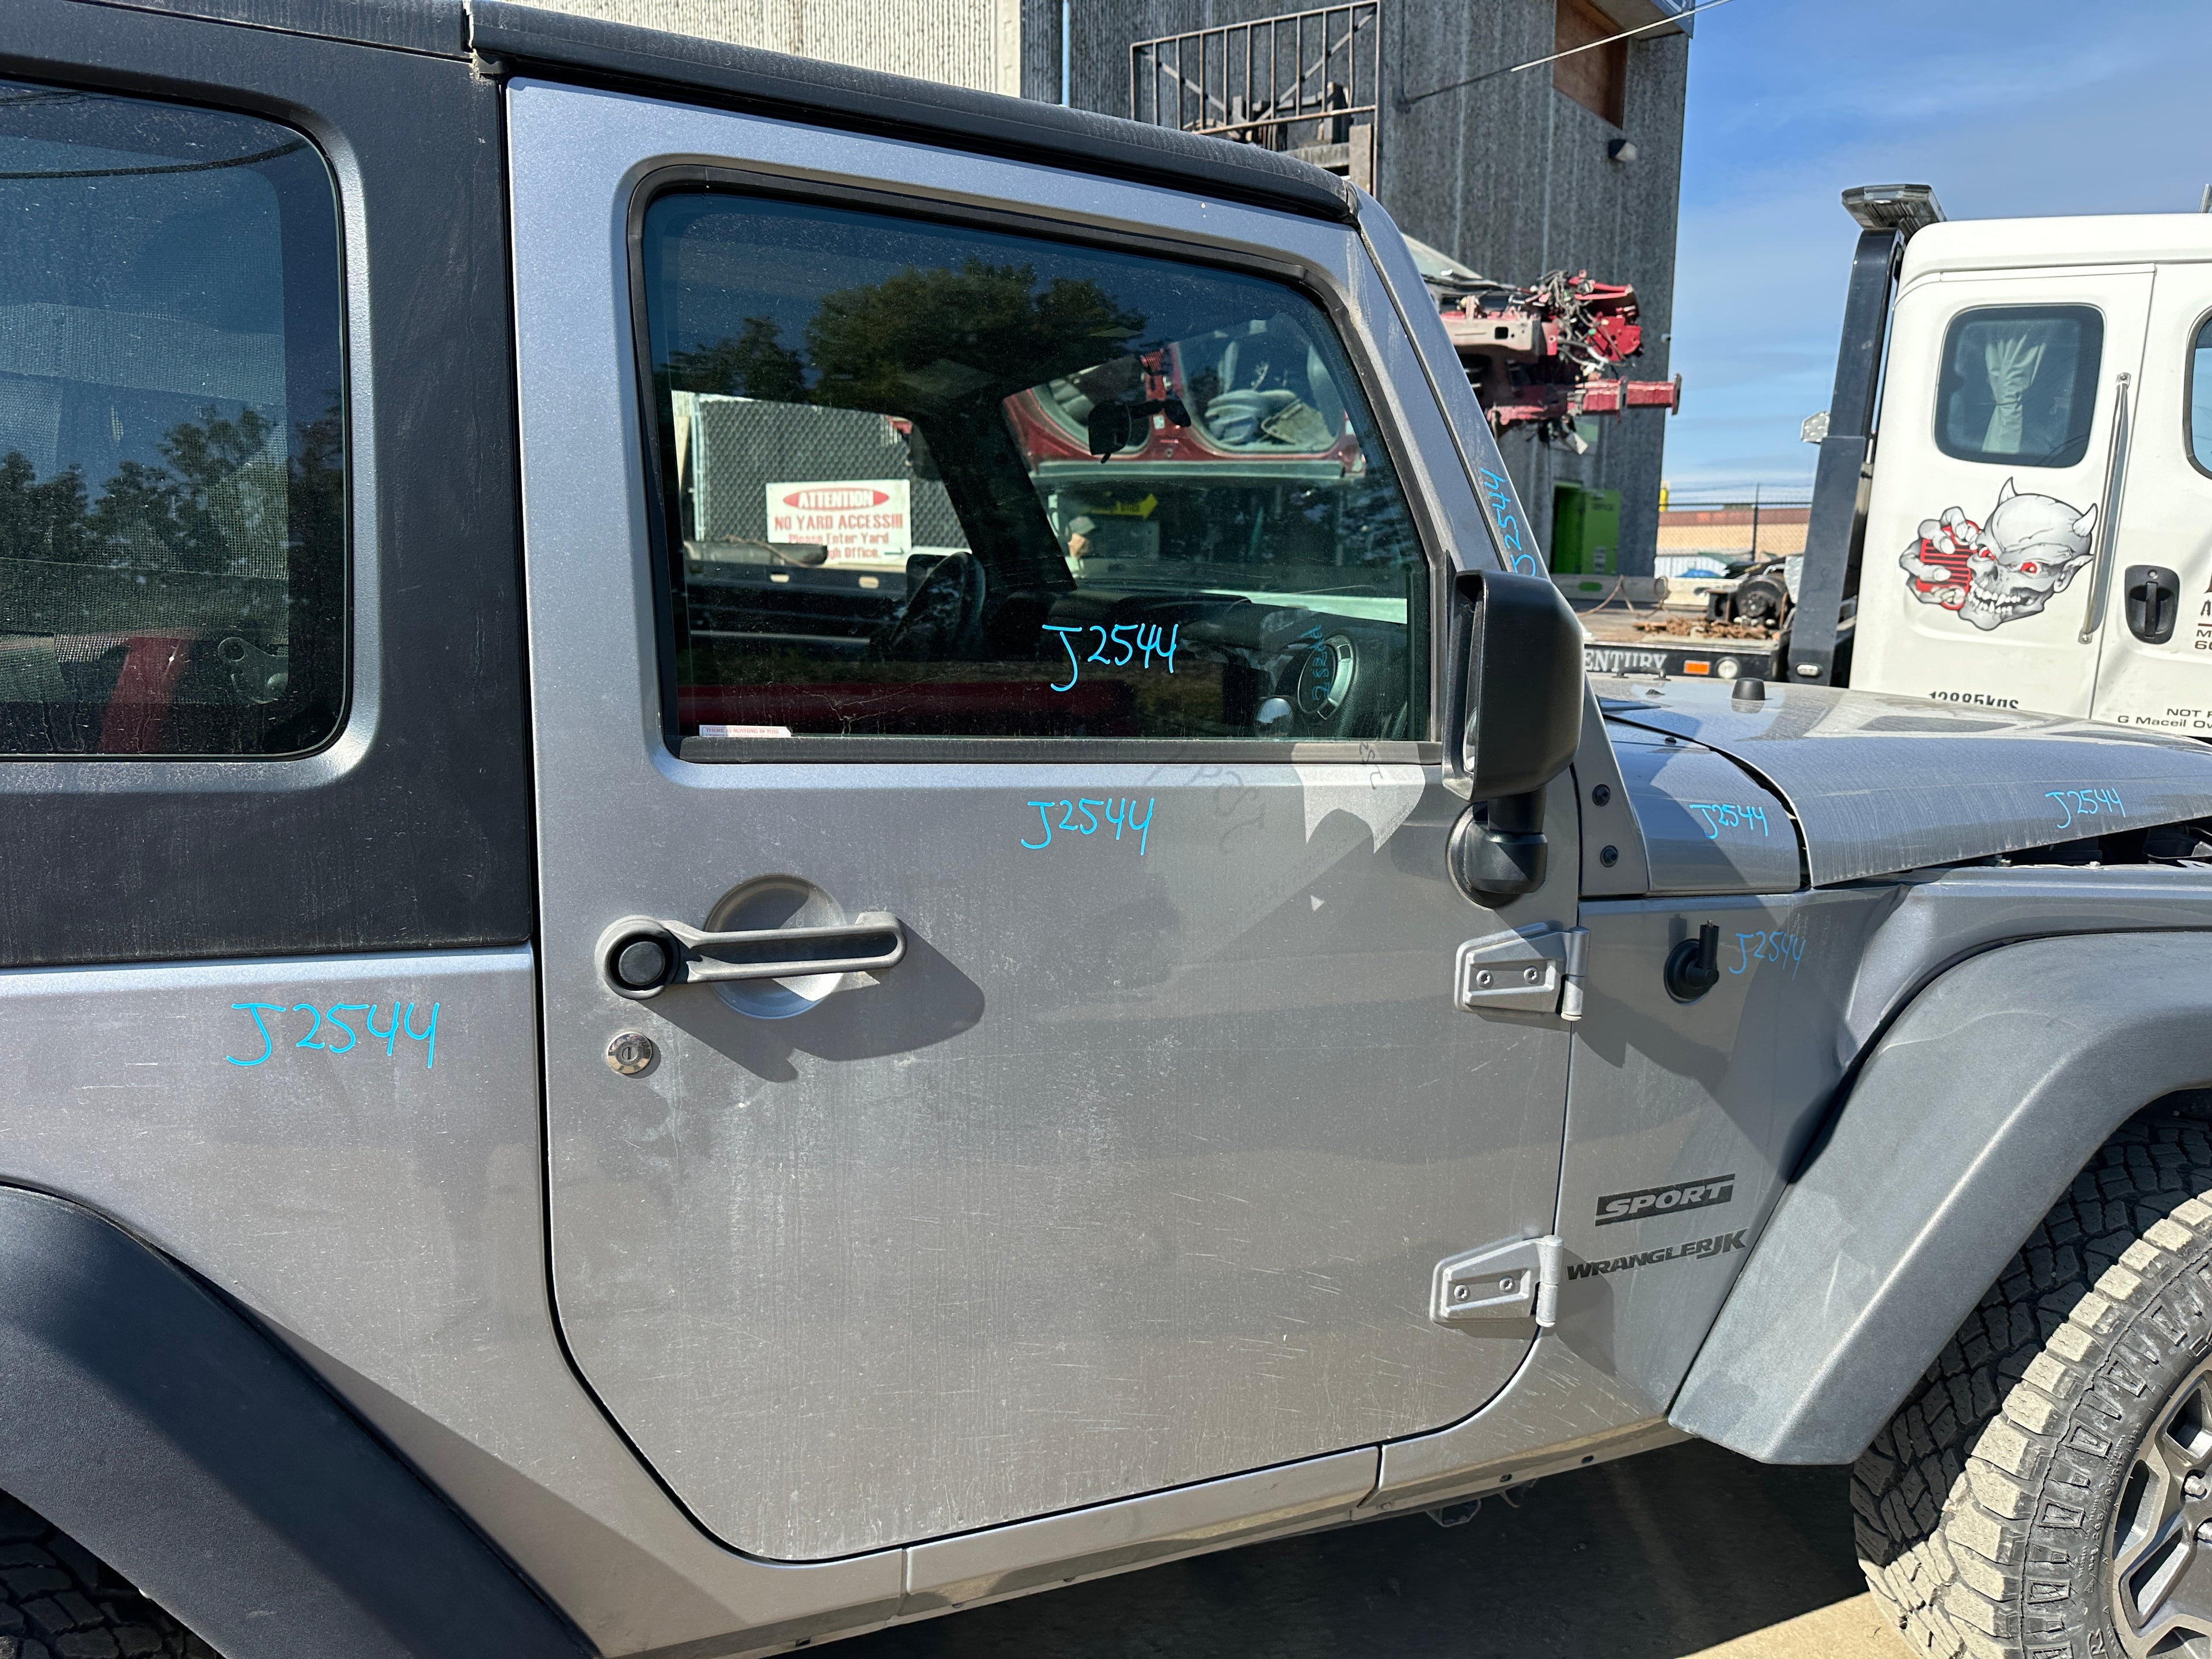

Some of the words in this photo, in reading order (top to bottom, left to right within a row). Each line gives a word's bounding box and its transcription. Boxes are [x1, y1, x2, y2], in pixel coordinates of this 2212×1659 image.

[798, 490, 874, 508] ATTENTION
[775, 515, 791, 531] NO
[797, 514, 834, 531] YARD
[827, 533, 858, 544] Enter
[861, 532, 889, 544] Yard
[1480, 467, 1536, 576] J2544
[1041, 623, 1179, 692] J2544
[1584, 649, 1667, 672] ENTURY
[2118, 715, 2130, 724] G
[2166, 709, 2202, 717] NOT
[1021, 797, 1155, 856] J2544
[1689, 804, 1768, 840] J2544
[2045, 787, 2126, 829] J2544
[1729, 931, 1806, 981] J2544
[225, 1001, 440, 1069] J2544
[1600, 1179, 1734, 1218] SPORT
